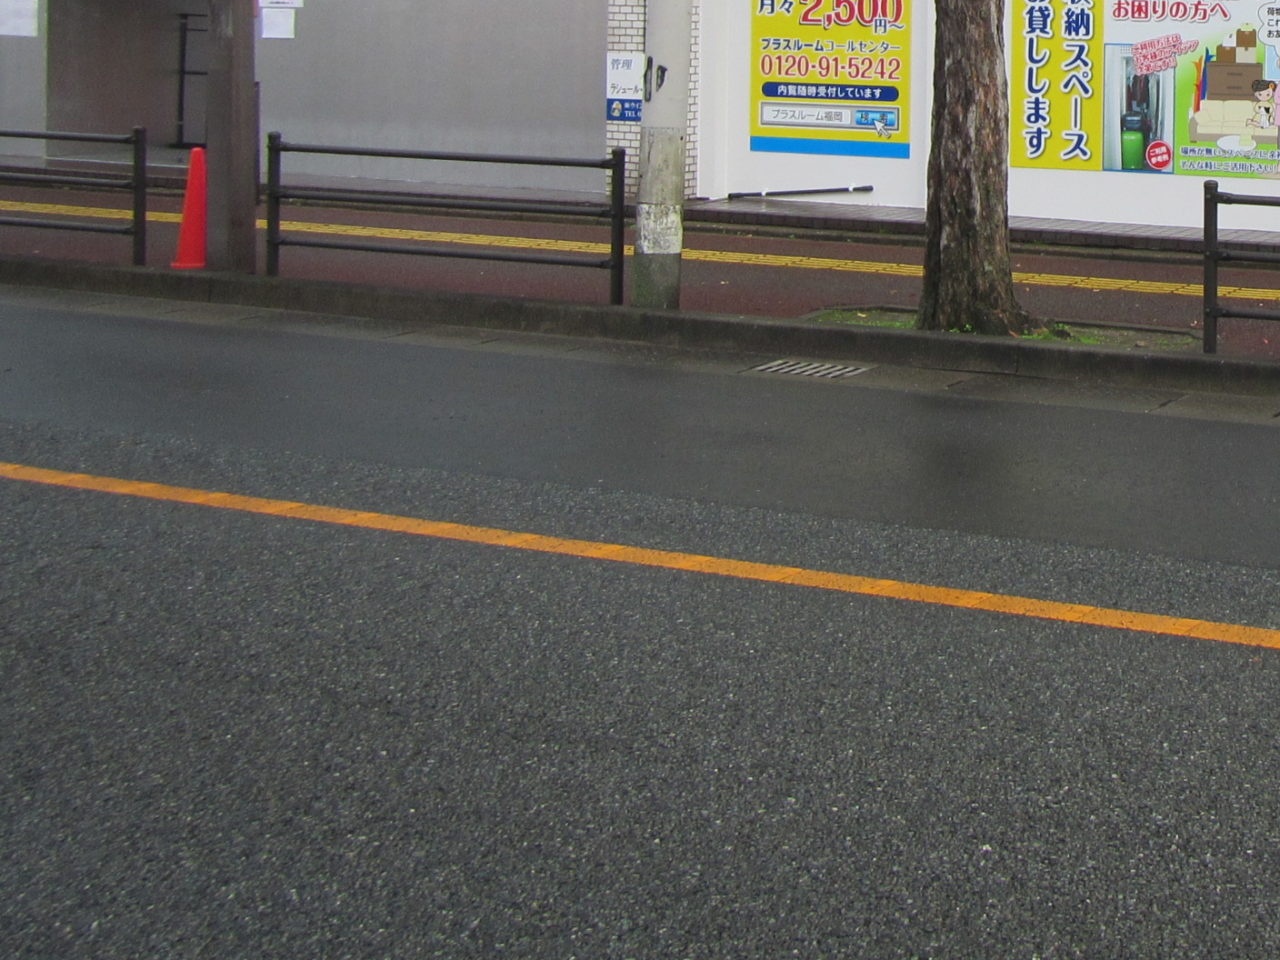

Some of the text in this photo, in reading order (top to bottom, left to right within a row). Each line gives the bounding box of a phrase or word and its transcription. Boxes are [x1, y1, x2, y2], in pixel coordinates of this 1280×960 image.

[1112, 0, 1229, 21] お困りの方へ
[761, 54, 901, 80] 0120-91-5242
[777, 84, 883, 100] 内覧随時受付しています
[771, 108, 844, 122] プラスルーム福岡
